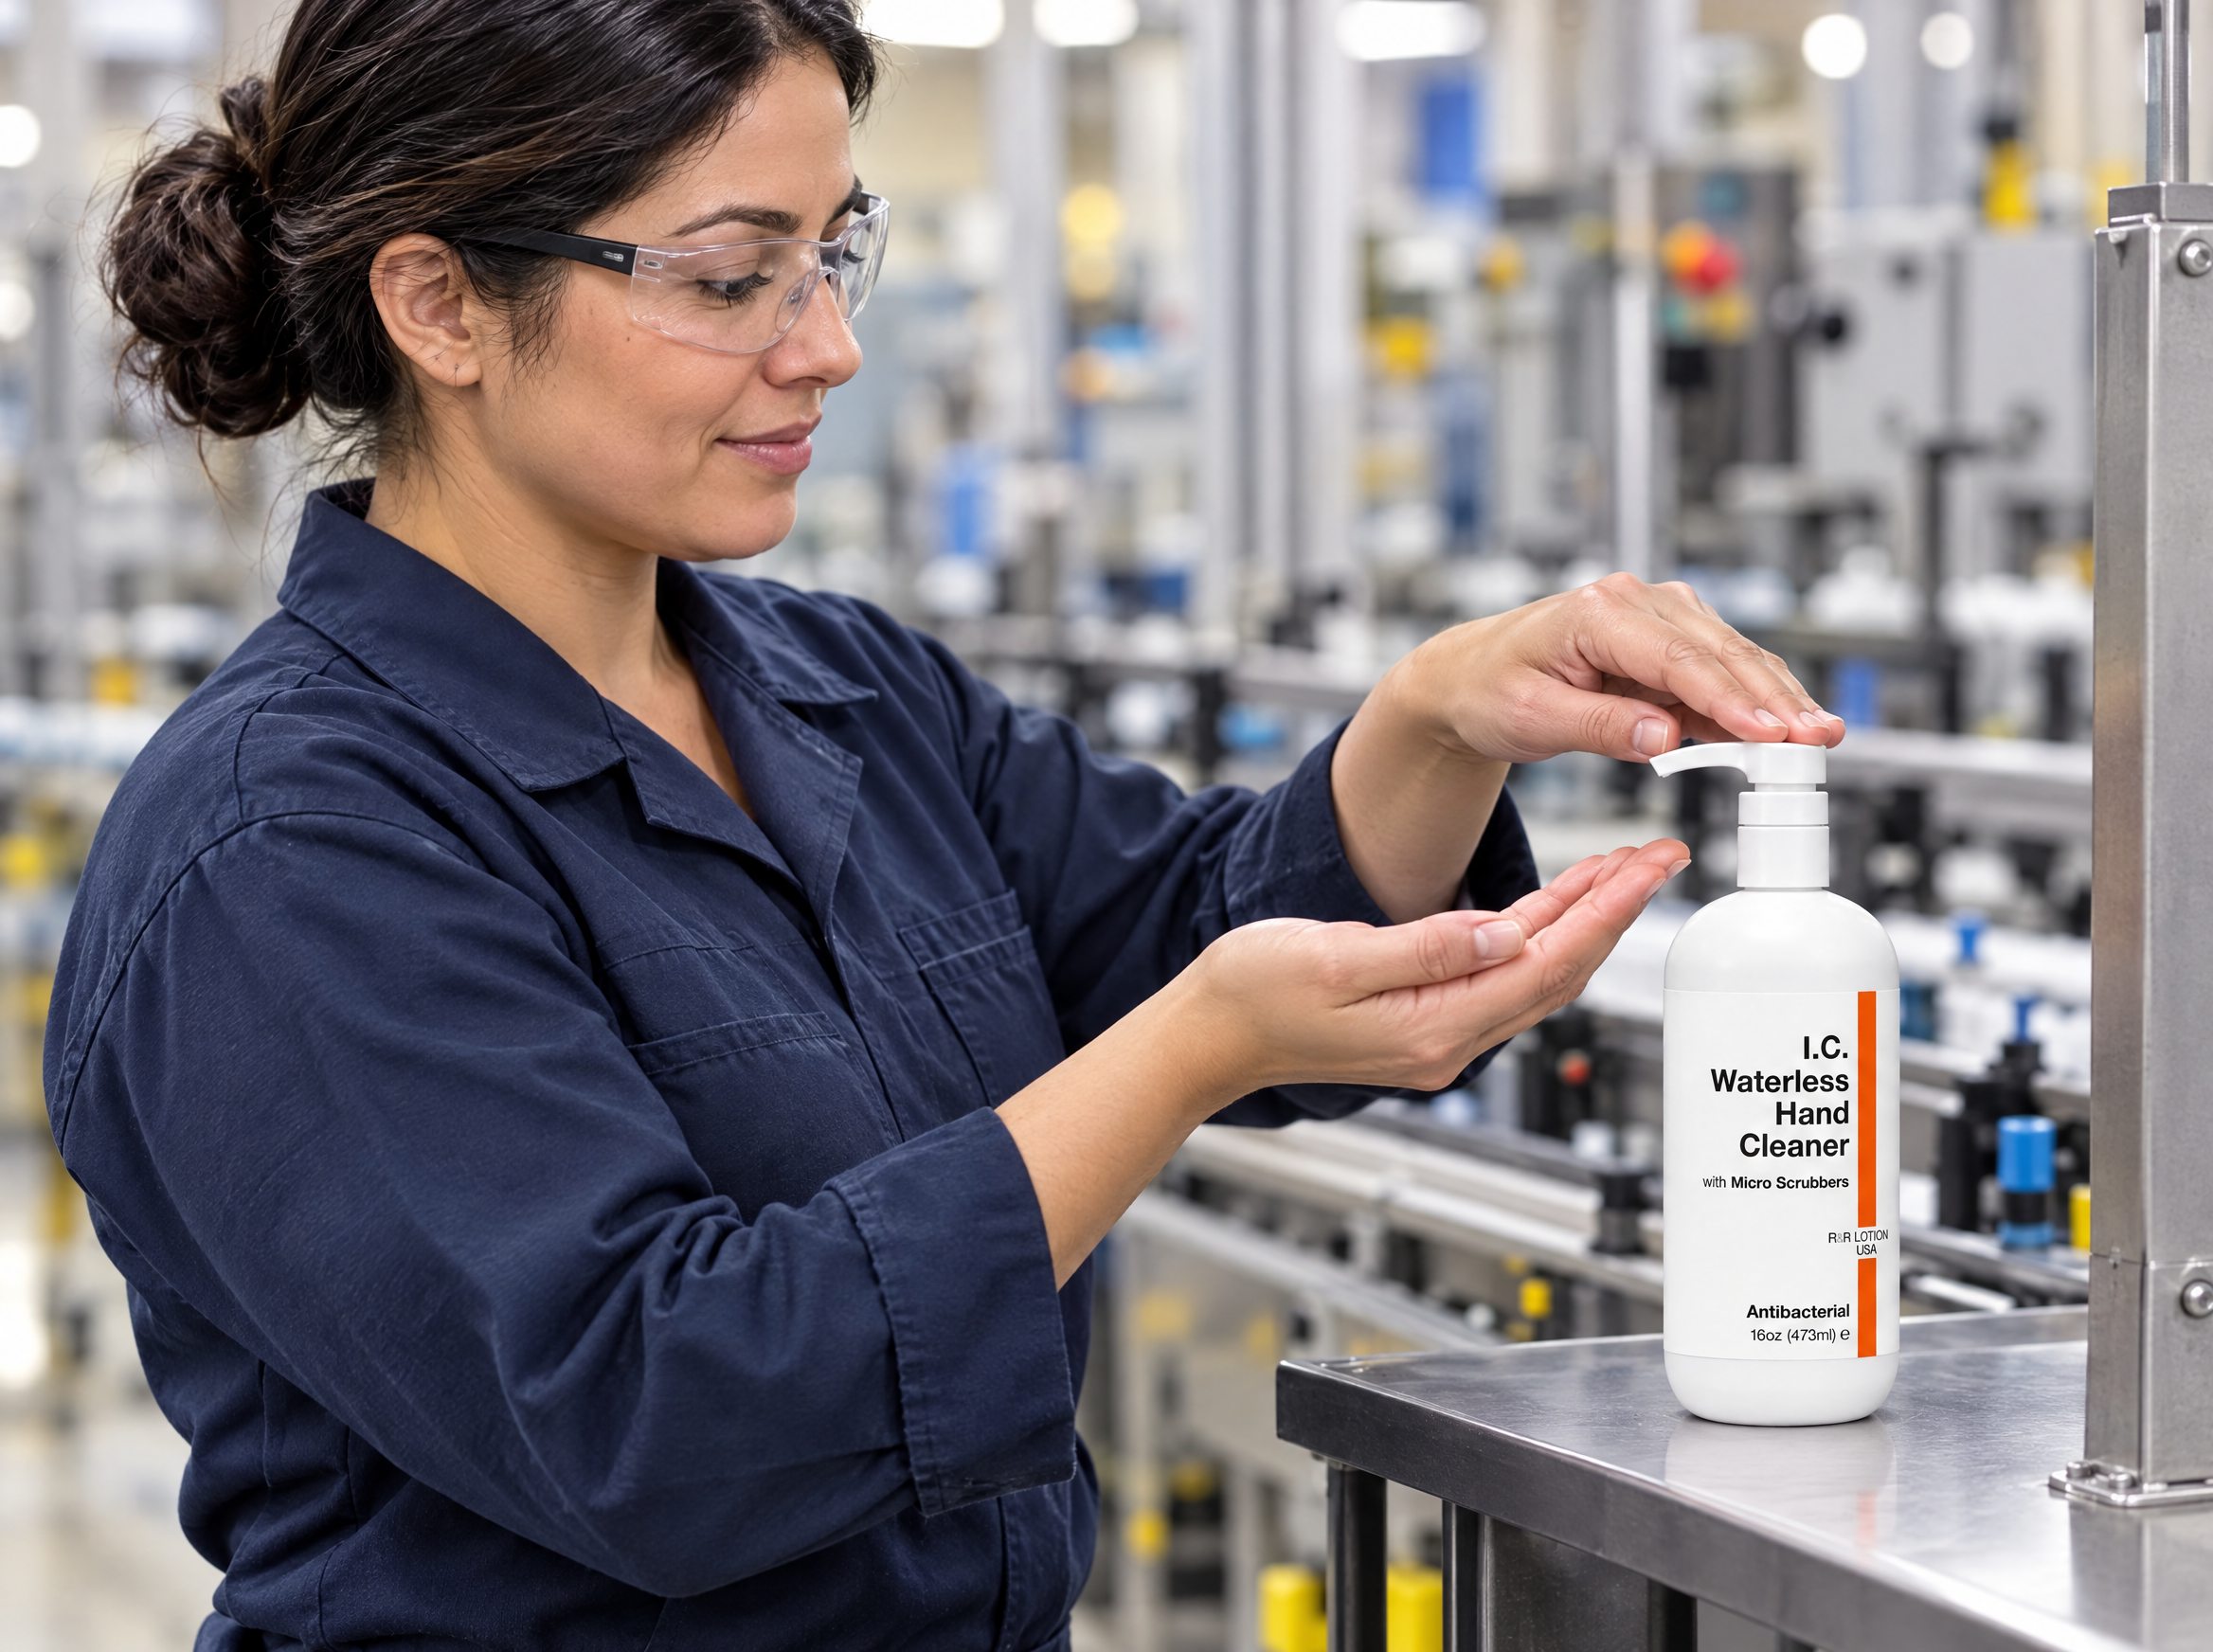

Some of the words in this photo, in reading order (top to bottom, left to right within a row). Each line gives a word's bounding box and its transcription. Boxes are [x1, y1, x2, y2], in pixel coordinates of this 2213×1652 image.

[1803, 1034, 1848, 1060] I.C.
[1711, 1068, 1849, 1093] Waterless
[1775, 1100, 1849, 1125] Hand
[1739, 1133, 1850, 1158] Cleaner
[1702, 1176, 1726, 1188] with
[1731, 1176, 1772, 1189] Micro
[1775, 1176, 1849, 1189] Scrubbers
[1828, 1231, 1851, 1244] R&R
[1854, 1230, 1889, 1242] LOTION
[1856, 1244, 1877, 1255] USA
[1746, 1303, 1850, 1319] Antibacterial
[1751, 1328, 1782, 1341] 16oz
[1787, 1328, 1836, 1344] (473ml)
